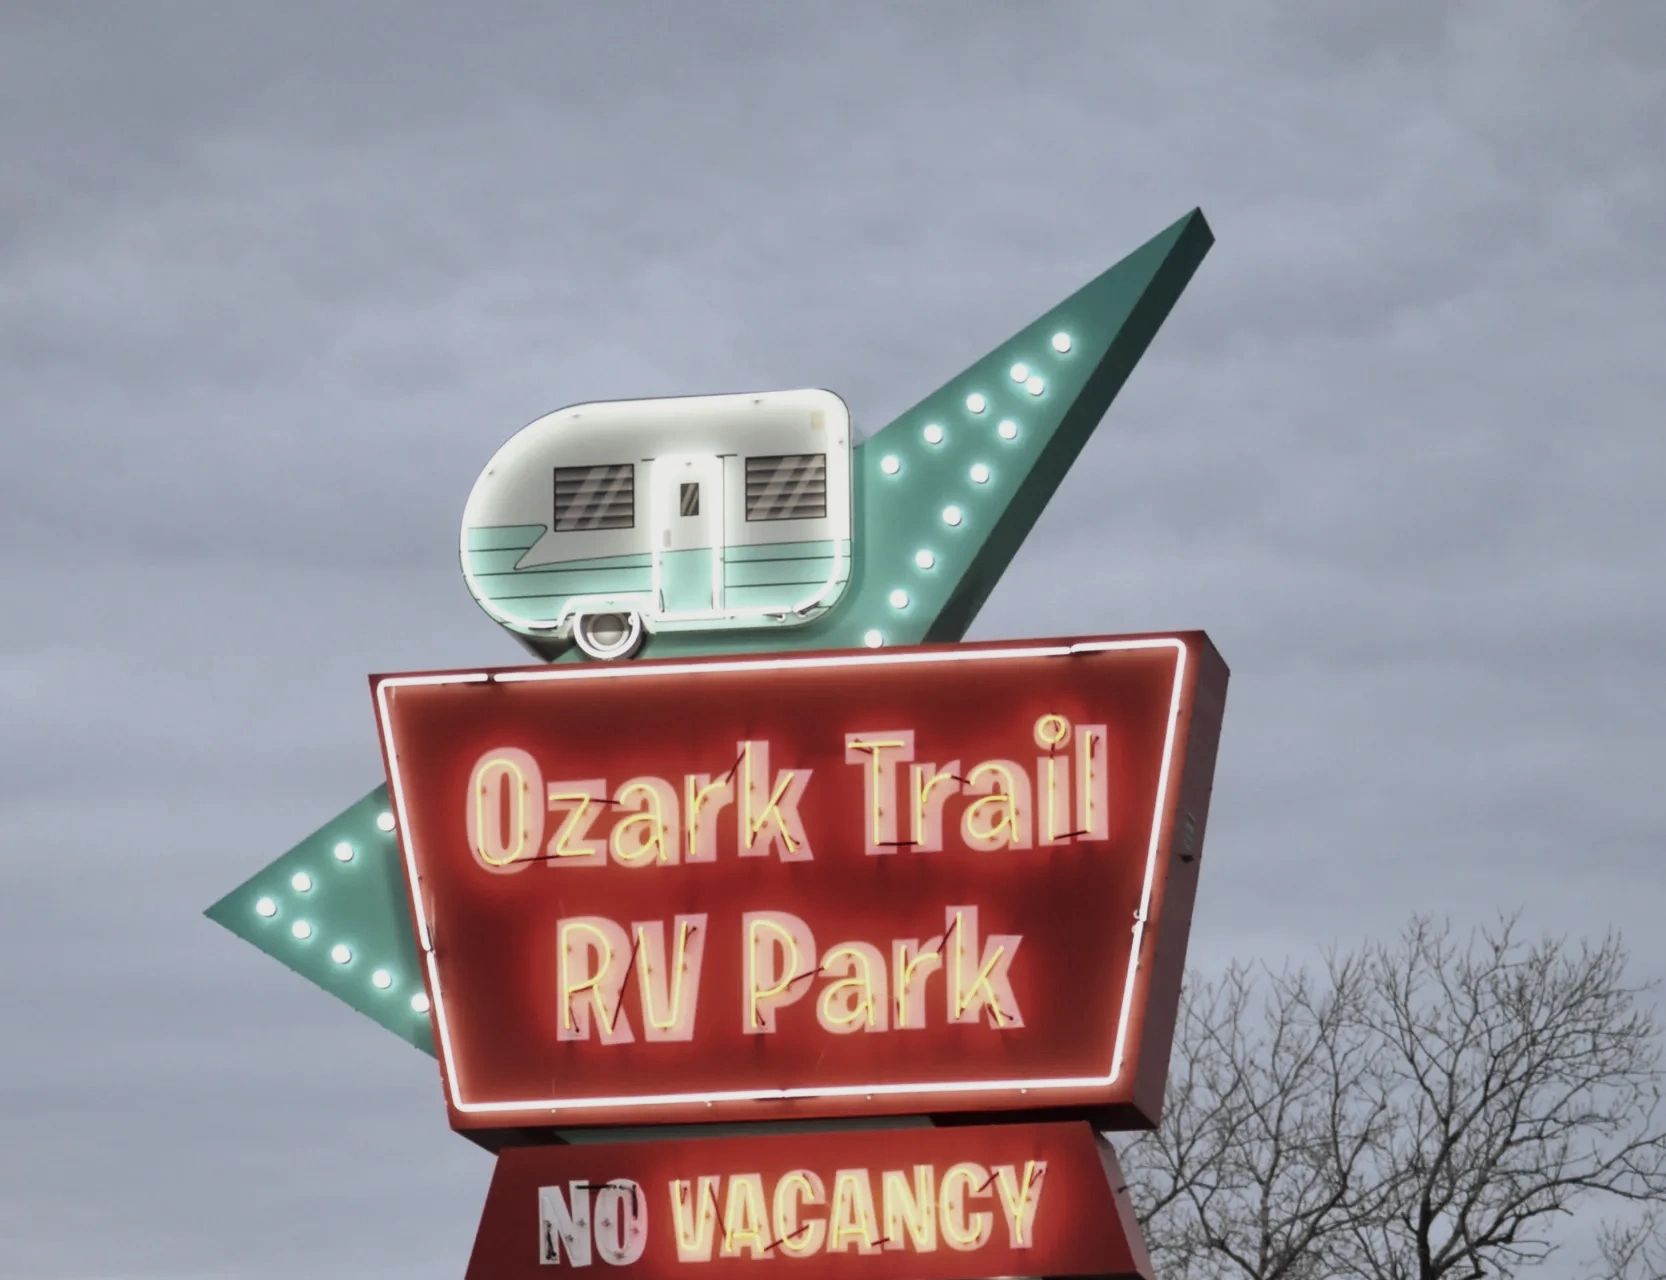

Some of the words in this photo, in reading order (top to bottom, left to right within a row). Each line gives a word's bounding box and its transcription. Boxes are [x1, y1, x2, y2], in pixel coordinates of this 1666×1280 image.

[465, 740, 814, 875] Ozark
[845, 714, 1109, 856] Trail
[555, 912, 709, 1046] RV
[741, 905, 1026, 1035] Park
[538, 1178, 648, 1268] NO
[670, 1160, 1048, 1264] VACANCY
